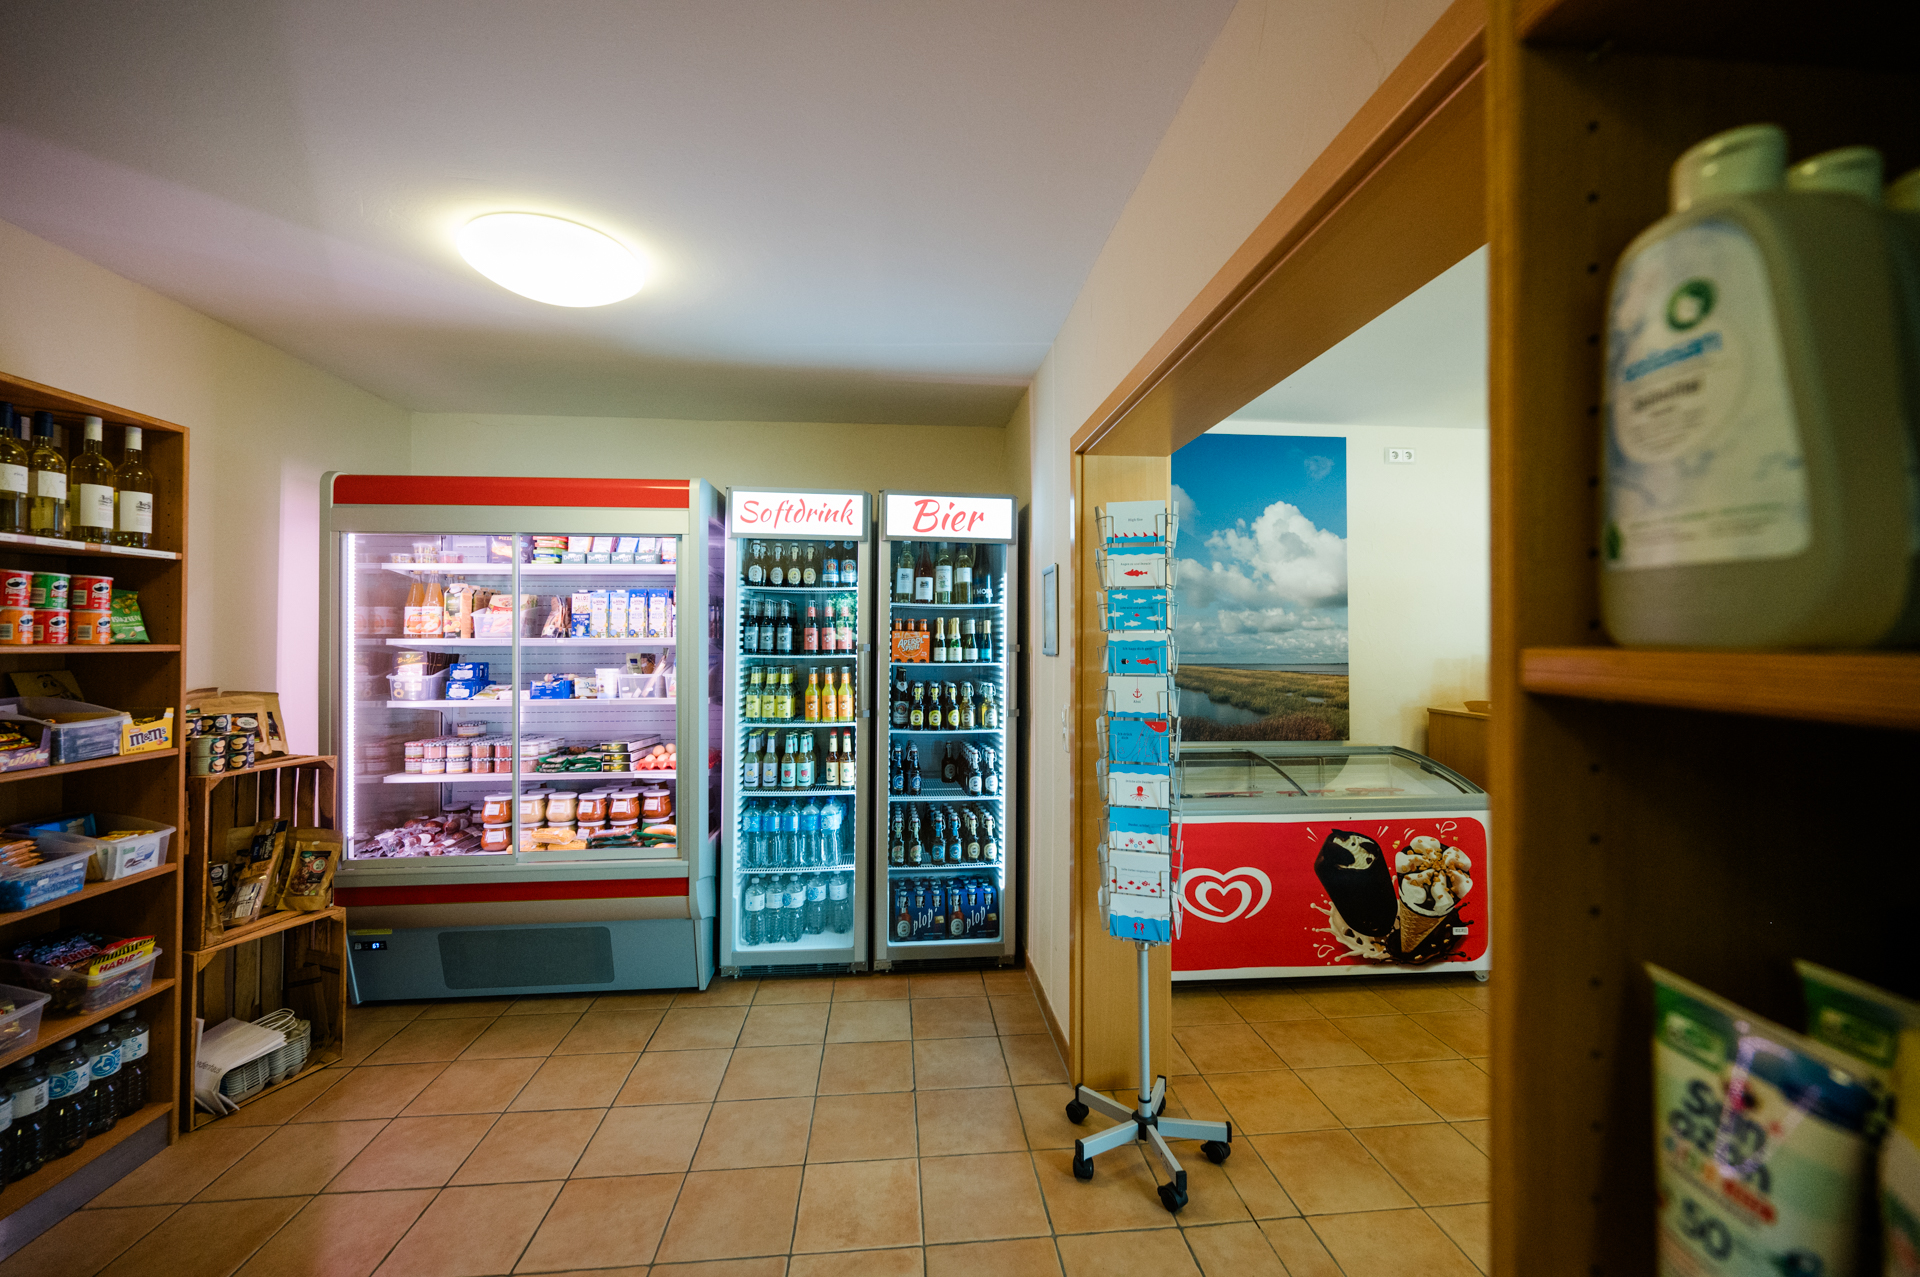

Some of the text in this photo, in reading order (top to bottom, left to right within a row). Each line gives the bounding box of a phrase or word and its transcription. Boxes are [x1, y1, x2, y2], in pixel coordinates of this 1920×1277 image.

[740, 498, 853, 529] Softdrink
[912, 498, 984, 533] Bier
[897, 636, 924, 648] APEROL
[902, 643, 920, 652] SPRITZ
[50, 945, 101, 967] HARIBO
